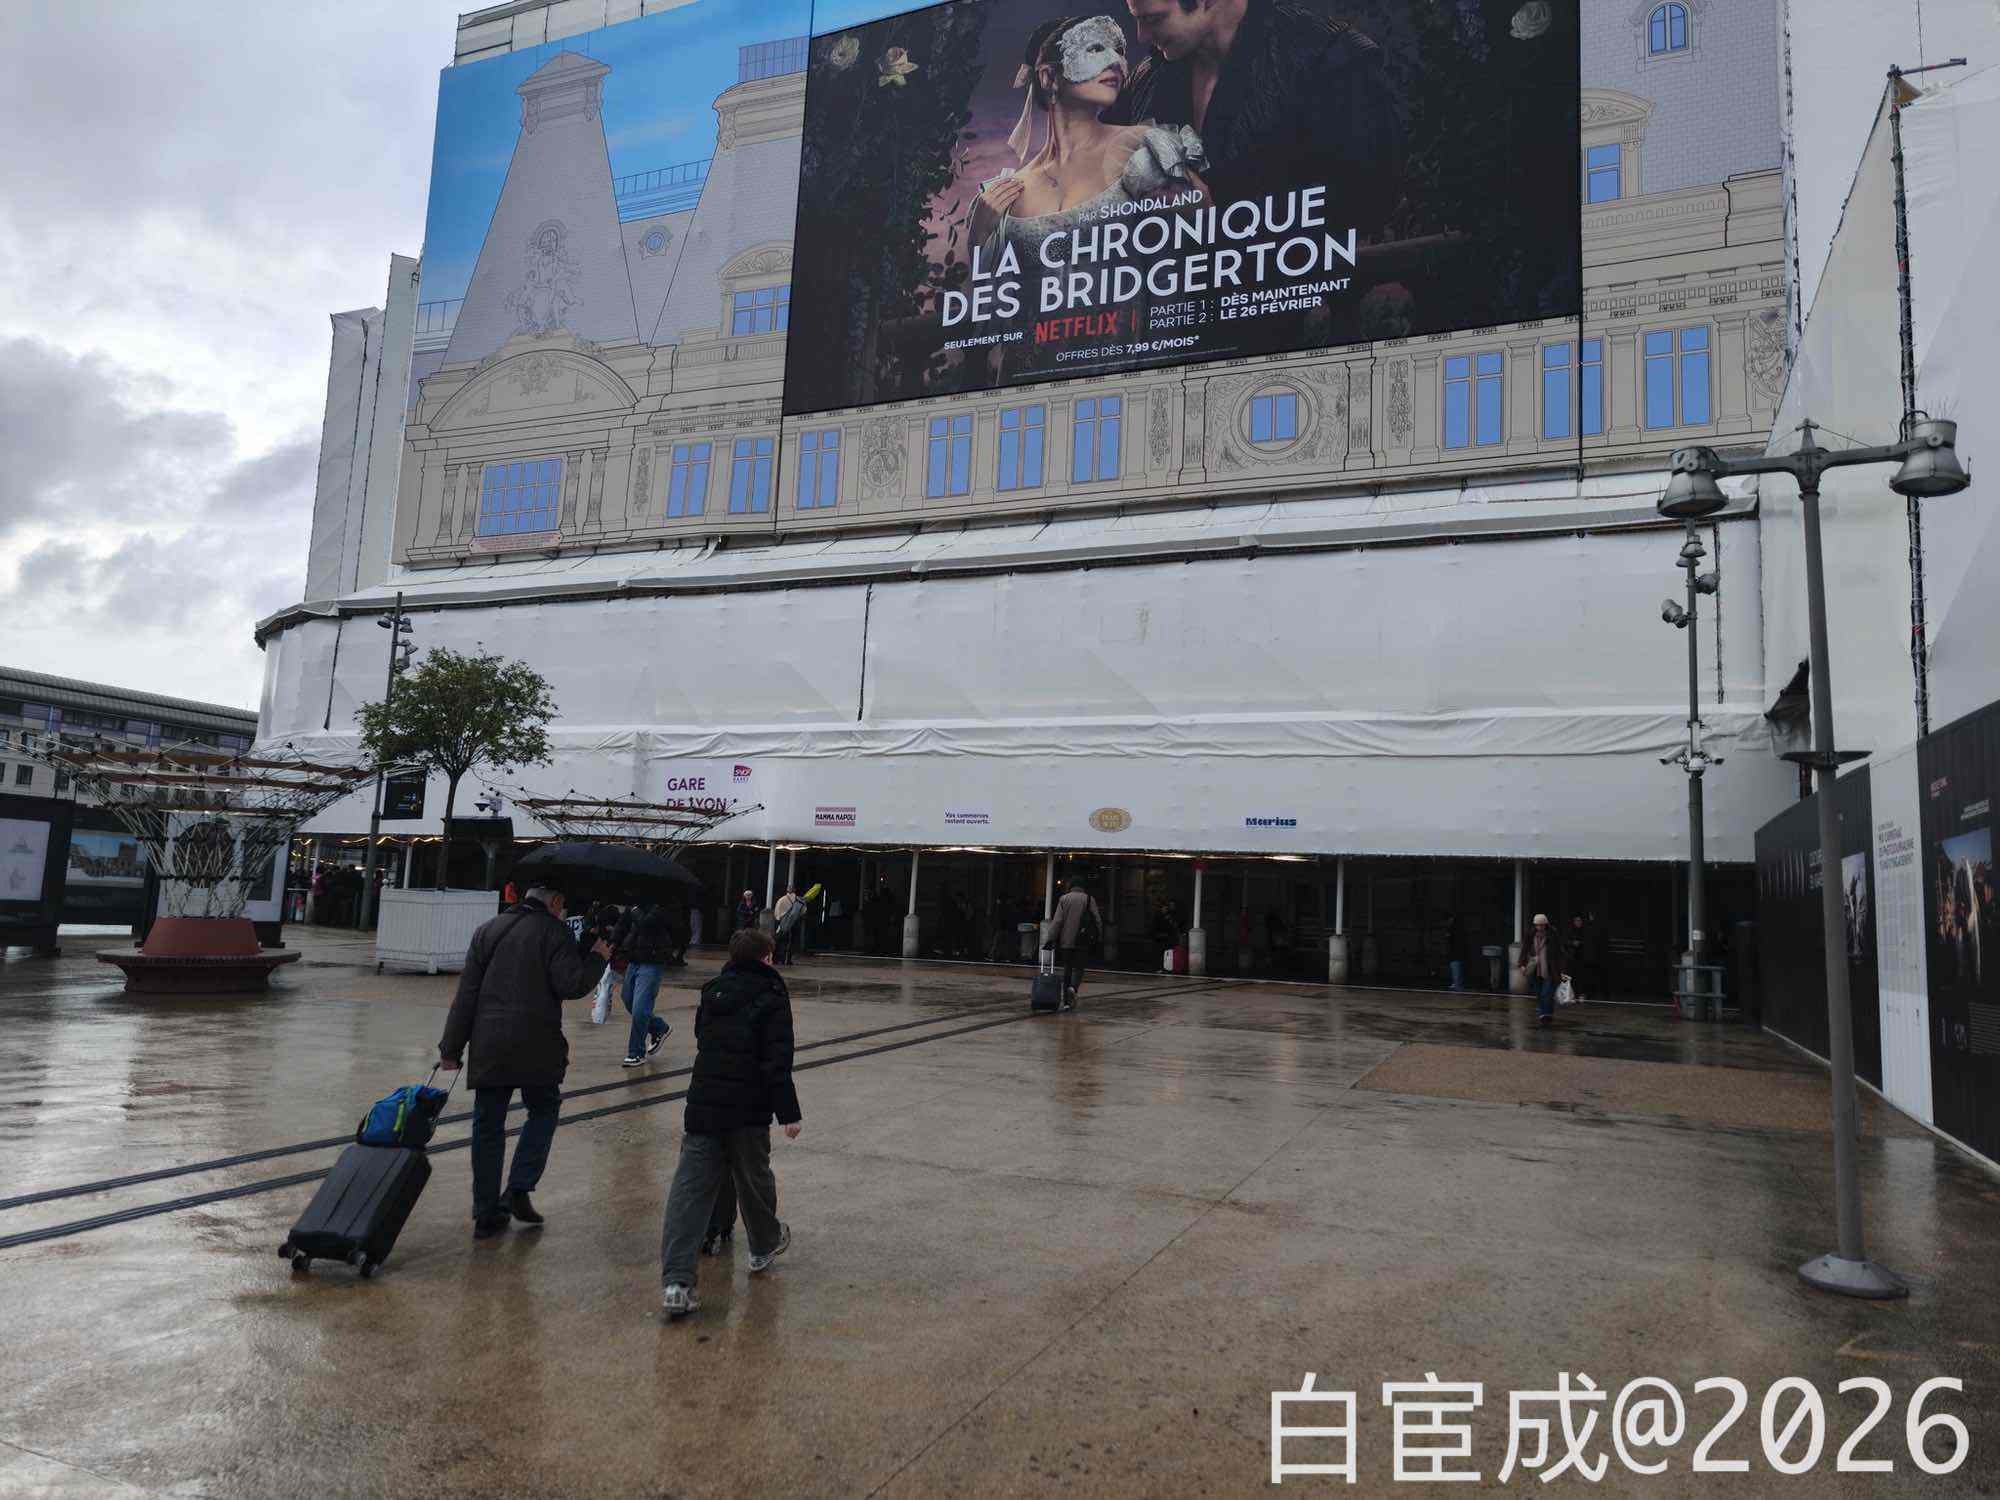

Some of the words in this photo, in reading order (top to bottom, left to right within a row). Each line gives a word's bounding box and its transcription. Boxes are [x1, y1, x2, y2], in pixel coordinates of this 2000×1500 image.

[1078, 212, 1097, 225] PAR
[1099, 189, 1203, 220] SHONDALAND
[971, 240, 1022, 282] LA
[1039, 185, 1326, 269] CHRONIQUE
[942, 281, 1022, 327] DES
[1040, 228, 1356, 313] BRIDGERTON
[1149, 314, 1195, 329] PARTIE
[1198, 312, 1207, 324] 2
[1220, 308, 1237, 320] LE
[1240, 305, 1258, 318] 26
[1260, 296, 1322, 314] FÉVRIER
[1150, 301, 1195, 317] PARTIE
[1220, 292, 1249, 307] DÈS
[1251, 278, 1351, 303] MAINTENANT
[943, 333, 1001, 350] SEULEMENT
[1003, 331, 1024, 343] SUR
[1034, 312, 1119, 345] NETFLIX
[1056, 347, 1099, 362] OFFRES
[1101, 344, 1124, 357] DÈS
[1126, 342, 1149, 355] 7,99
[667, 777, 706, 791] GARE
[667, 798, 685, 808] DE
[835, 813, 857, 821] NAPOLI
[1246, 816, 1297, 826] Marius
